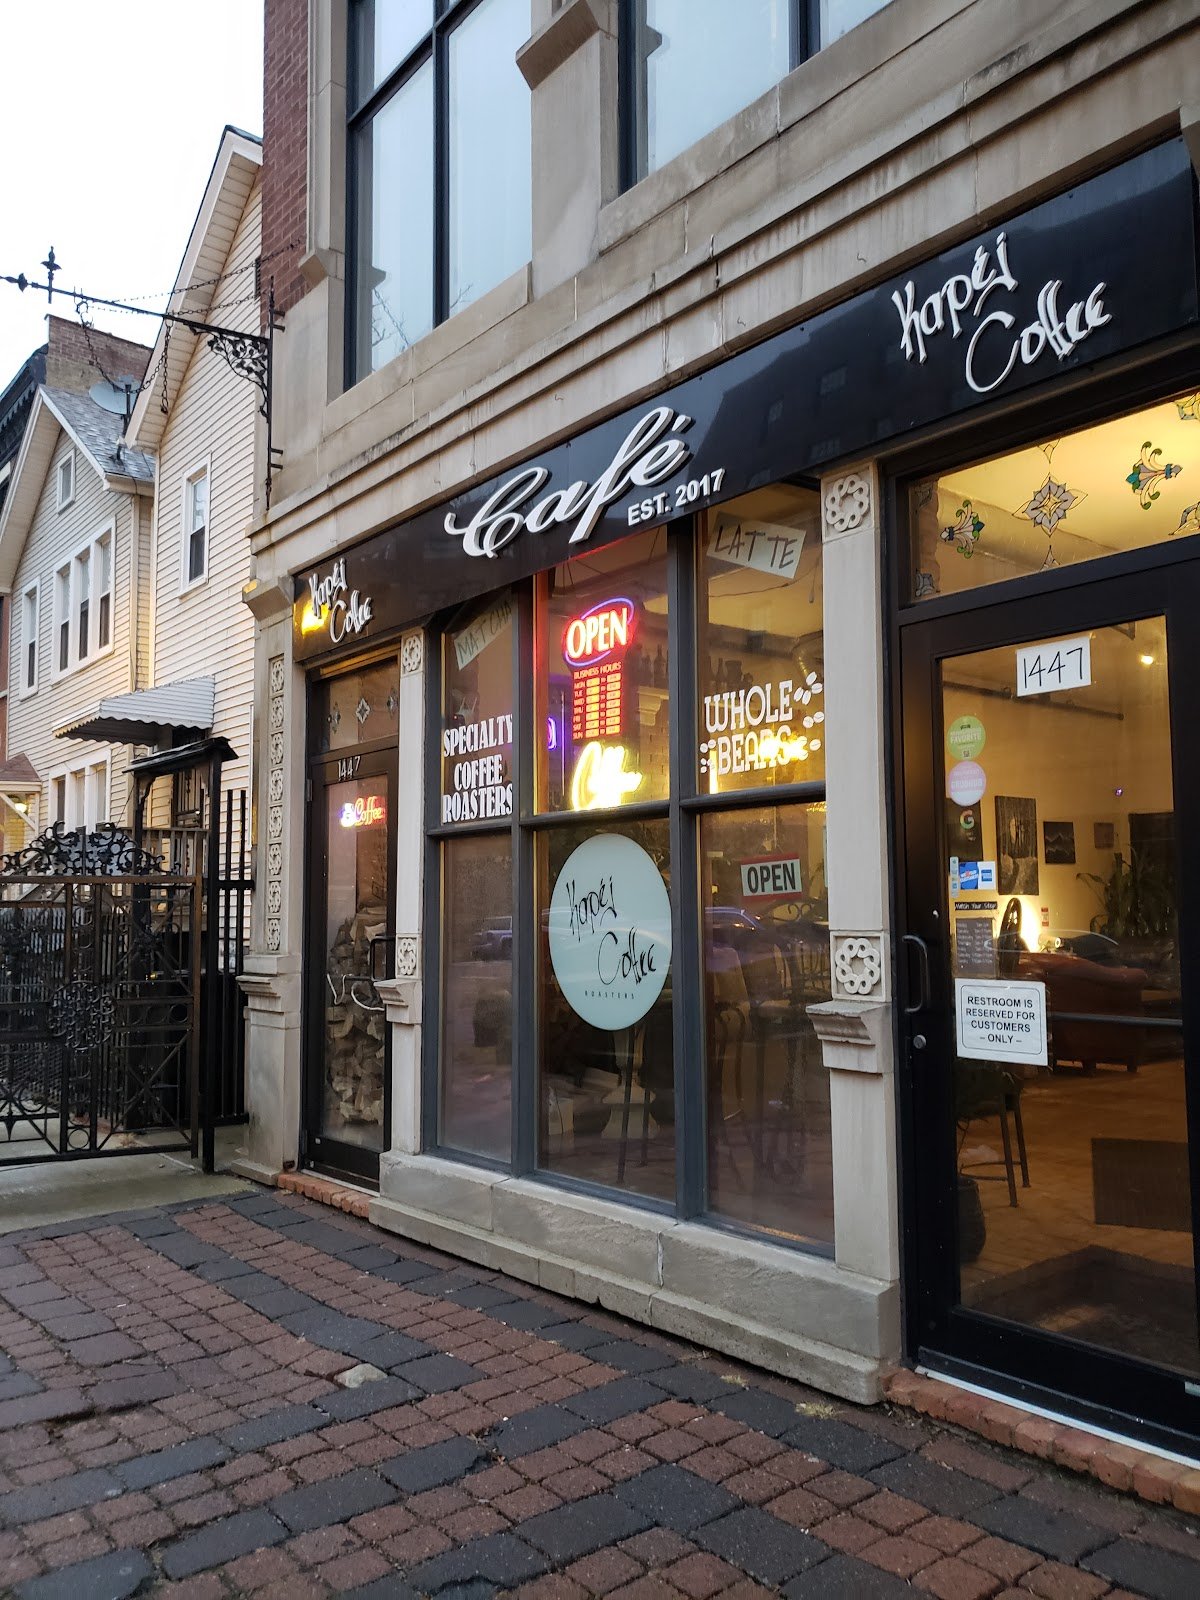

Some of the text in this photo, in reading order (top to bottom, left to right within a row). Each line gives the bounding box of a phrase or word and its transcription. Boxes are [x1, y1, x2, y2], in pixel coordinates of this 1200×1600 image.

[965, 279, 1112, 393] Coffee
[444, 406, 691, 559] Café
[627, 468, 726, 526] EST. 2017
[330, 590, 373, 643] Coffee
[566, 607, 628, 659] OPEN
[600, 661, 622, 674] HOURS
[1023, 647, 1083, 689] 1447
[704, 680, 793, 733] WHOLE
[443, 713, 513, 758] SPECIALTY
[338, 756, 361, 781] 1447
[454, 754, 503, 791] COFFEE
[355, 796, 384, 826] Coffee
[442, 783, 513, 824] ROASTERS
[746, 862, 796, 894] OPEN
[598, 926, 657, 986] Coffee
[585, 990, 634, 1000] ROASTERS
[966, 1008, 1035, 1021] RESERVED FOR
[967, 996, 1033, 1008] RESTROOM IS
[971, 1020, 1031, 1033] CUSTOMERS
[987, 1033, 1014, 1044] ONLY
